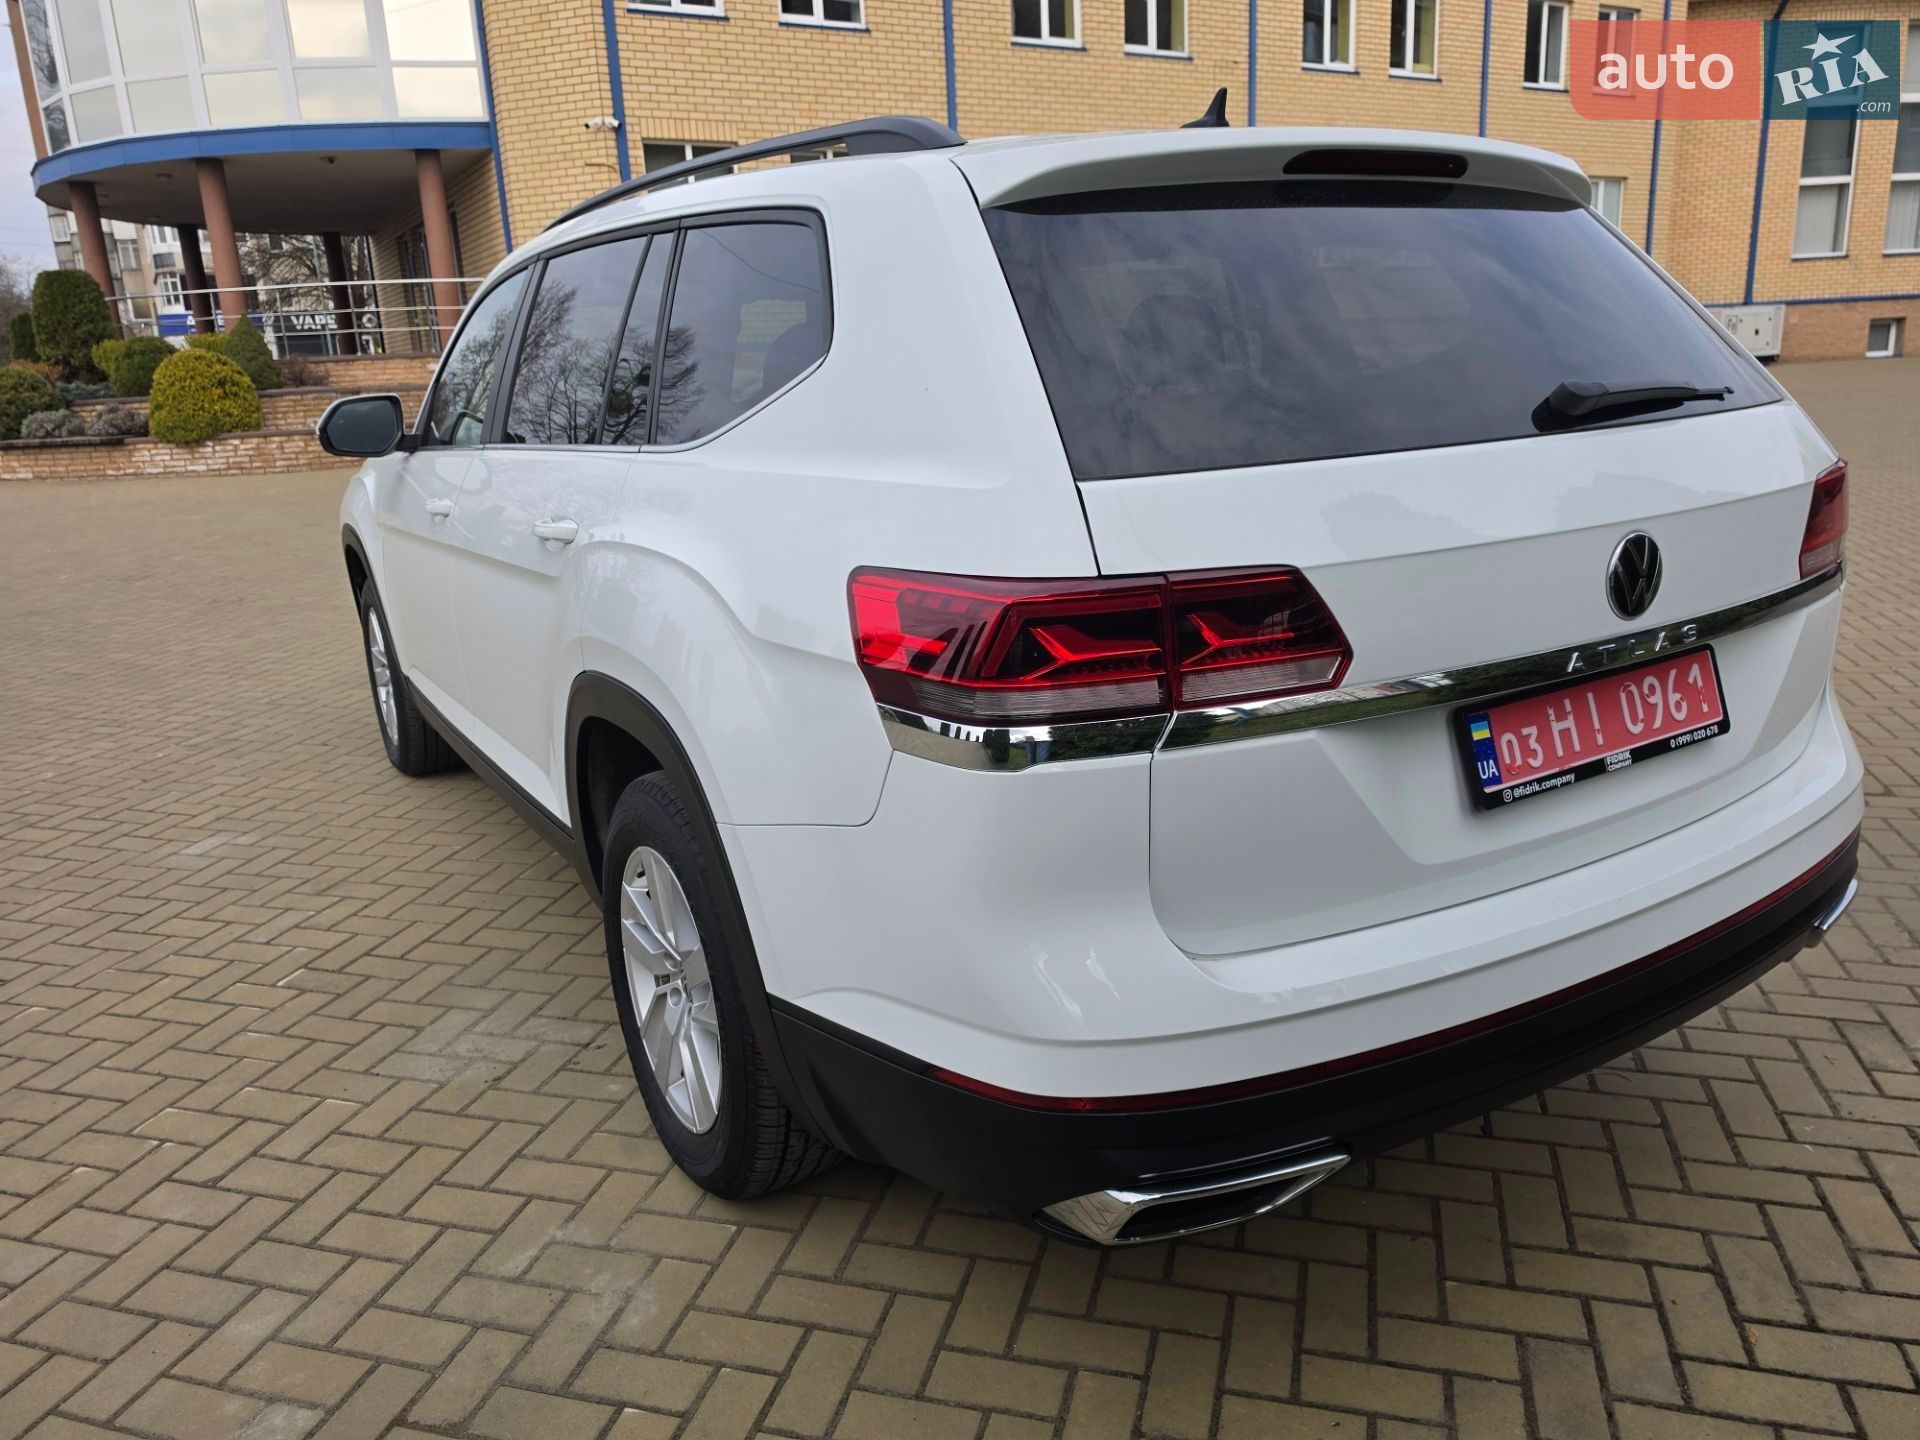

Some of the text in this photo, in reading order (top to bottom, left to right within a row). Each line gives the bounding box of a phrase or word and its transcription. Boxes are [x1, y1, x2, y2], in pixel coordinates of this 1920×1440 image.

[290, 313, 338, 330] VAPE
[1566, 624, 1697, 672] ATLAS
[1501, 725, 1544, 774] 03
[1620, 663, 1709, 735] 0961
[1670, 724, 1719, 748] 0 (999) 020 678
[1478, 759, 1499, 779] UA
[1606, 750, 1632, 765] FIDRIK
[1513, 772, 1575, 798] @fidrik.company
